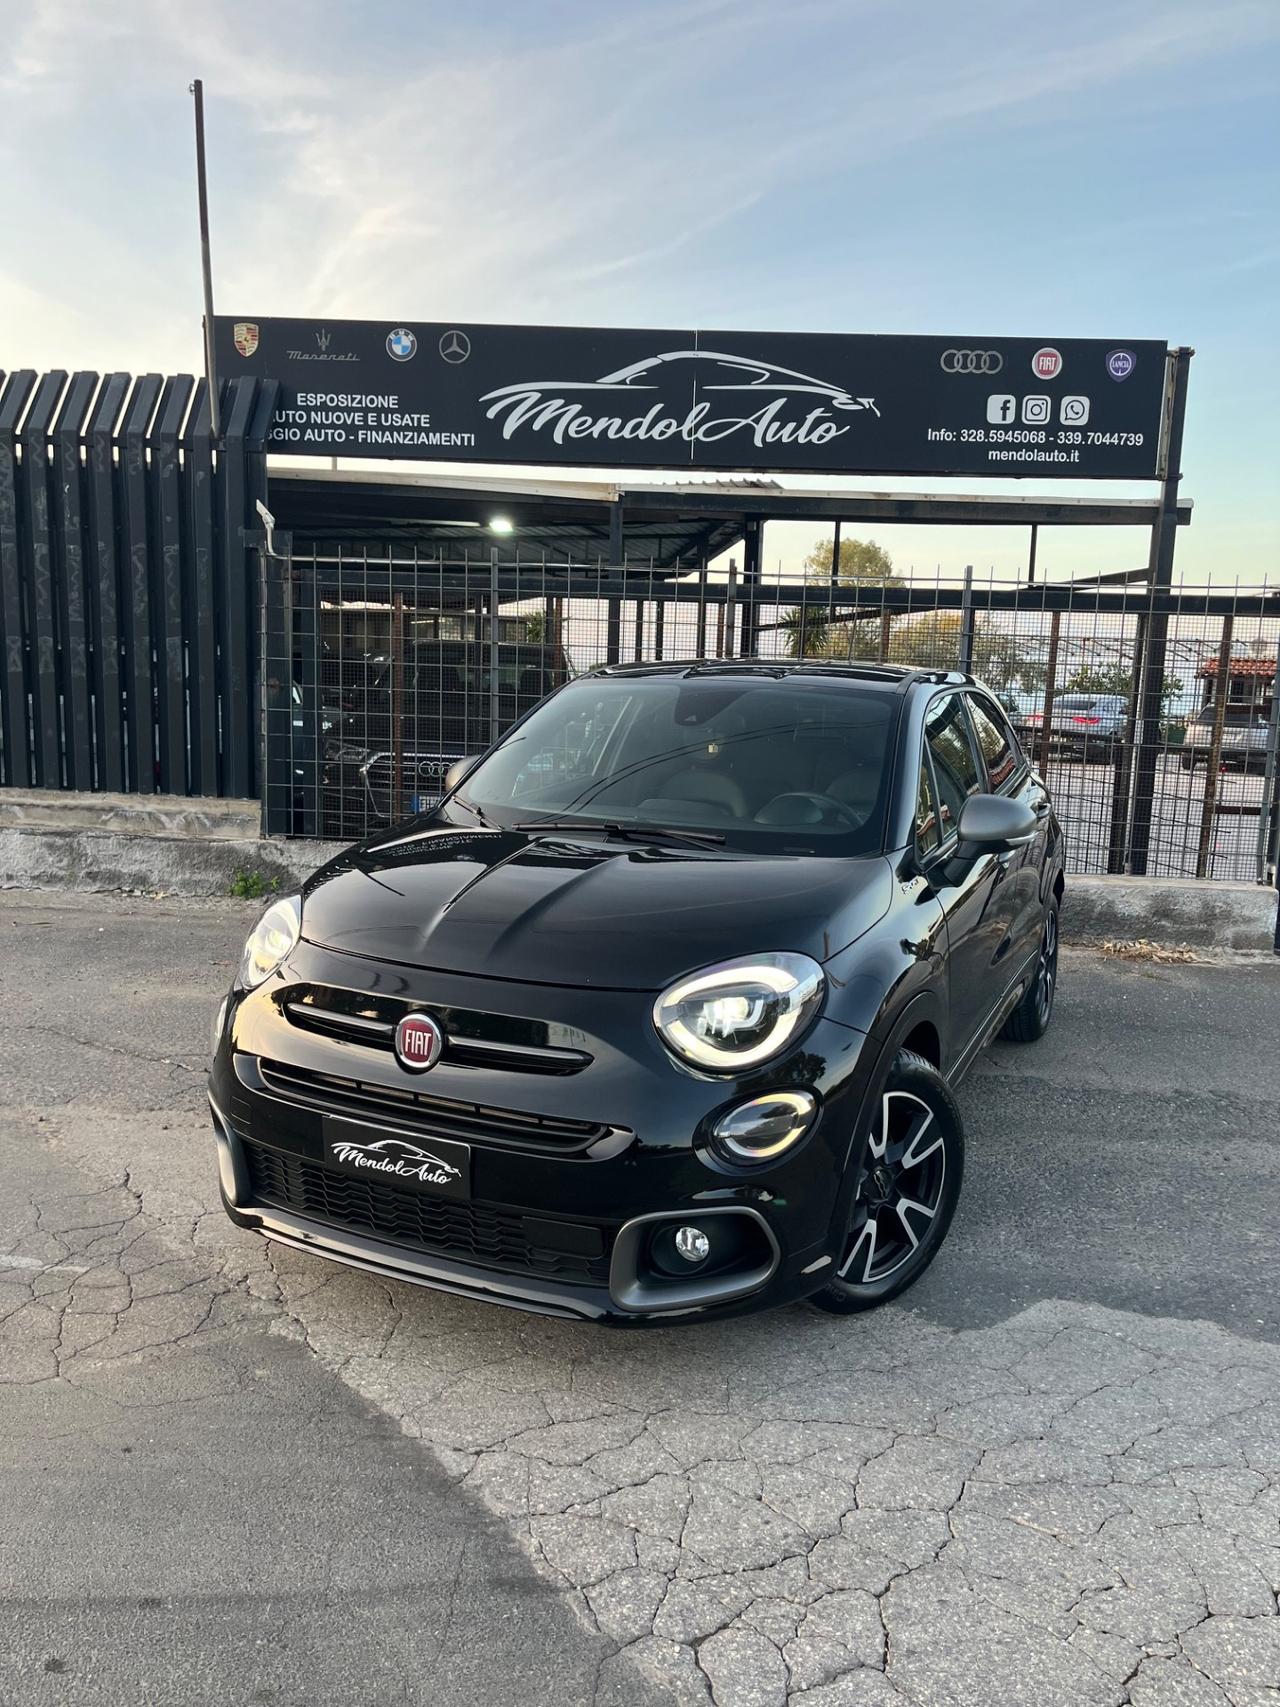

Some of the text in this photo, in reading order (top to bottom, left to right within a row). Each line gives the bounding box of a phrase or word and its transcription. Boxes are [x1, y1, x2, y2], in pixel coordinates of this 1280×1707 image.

[287, 350, 360, 361] Maserati
[1039, 356, 1057, 371] FIAT
[296, 392, 399, 409] ESPOSIZIONE
[272, 410, 431, 428] UTO NUOVE E USATE
[303, 428, 346, 443] AUTO
[357, 430, 475, 447] FINANZIAMENTI
[927, 428, 957, 442] Info:
[960, 429, 1046, 444] 328.5945068
[1057, 431, 1144, 447] 339.7044739
[988, 448, 1080, 463] mendolauto.it
[405, 1029, 432, 1056] FIAT
